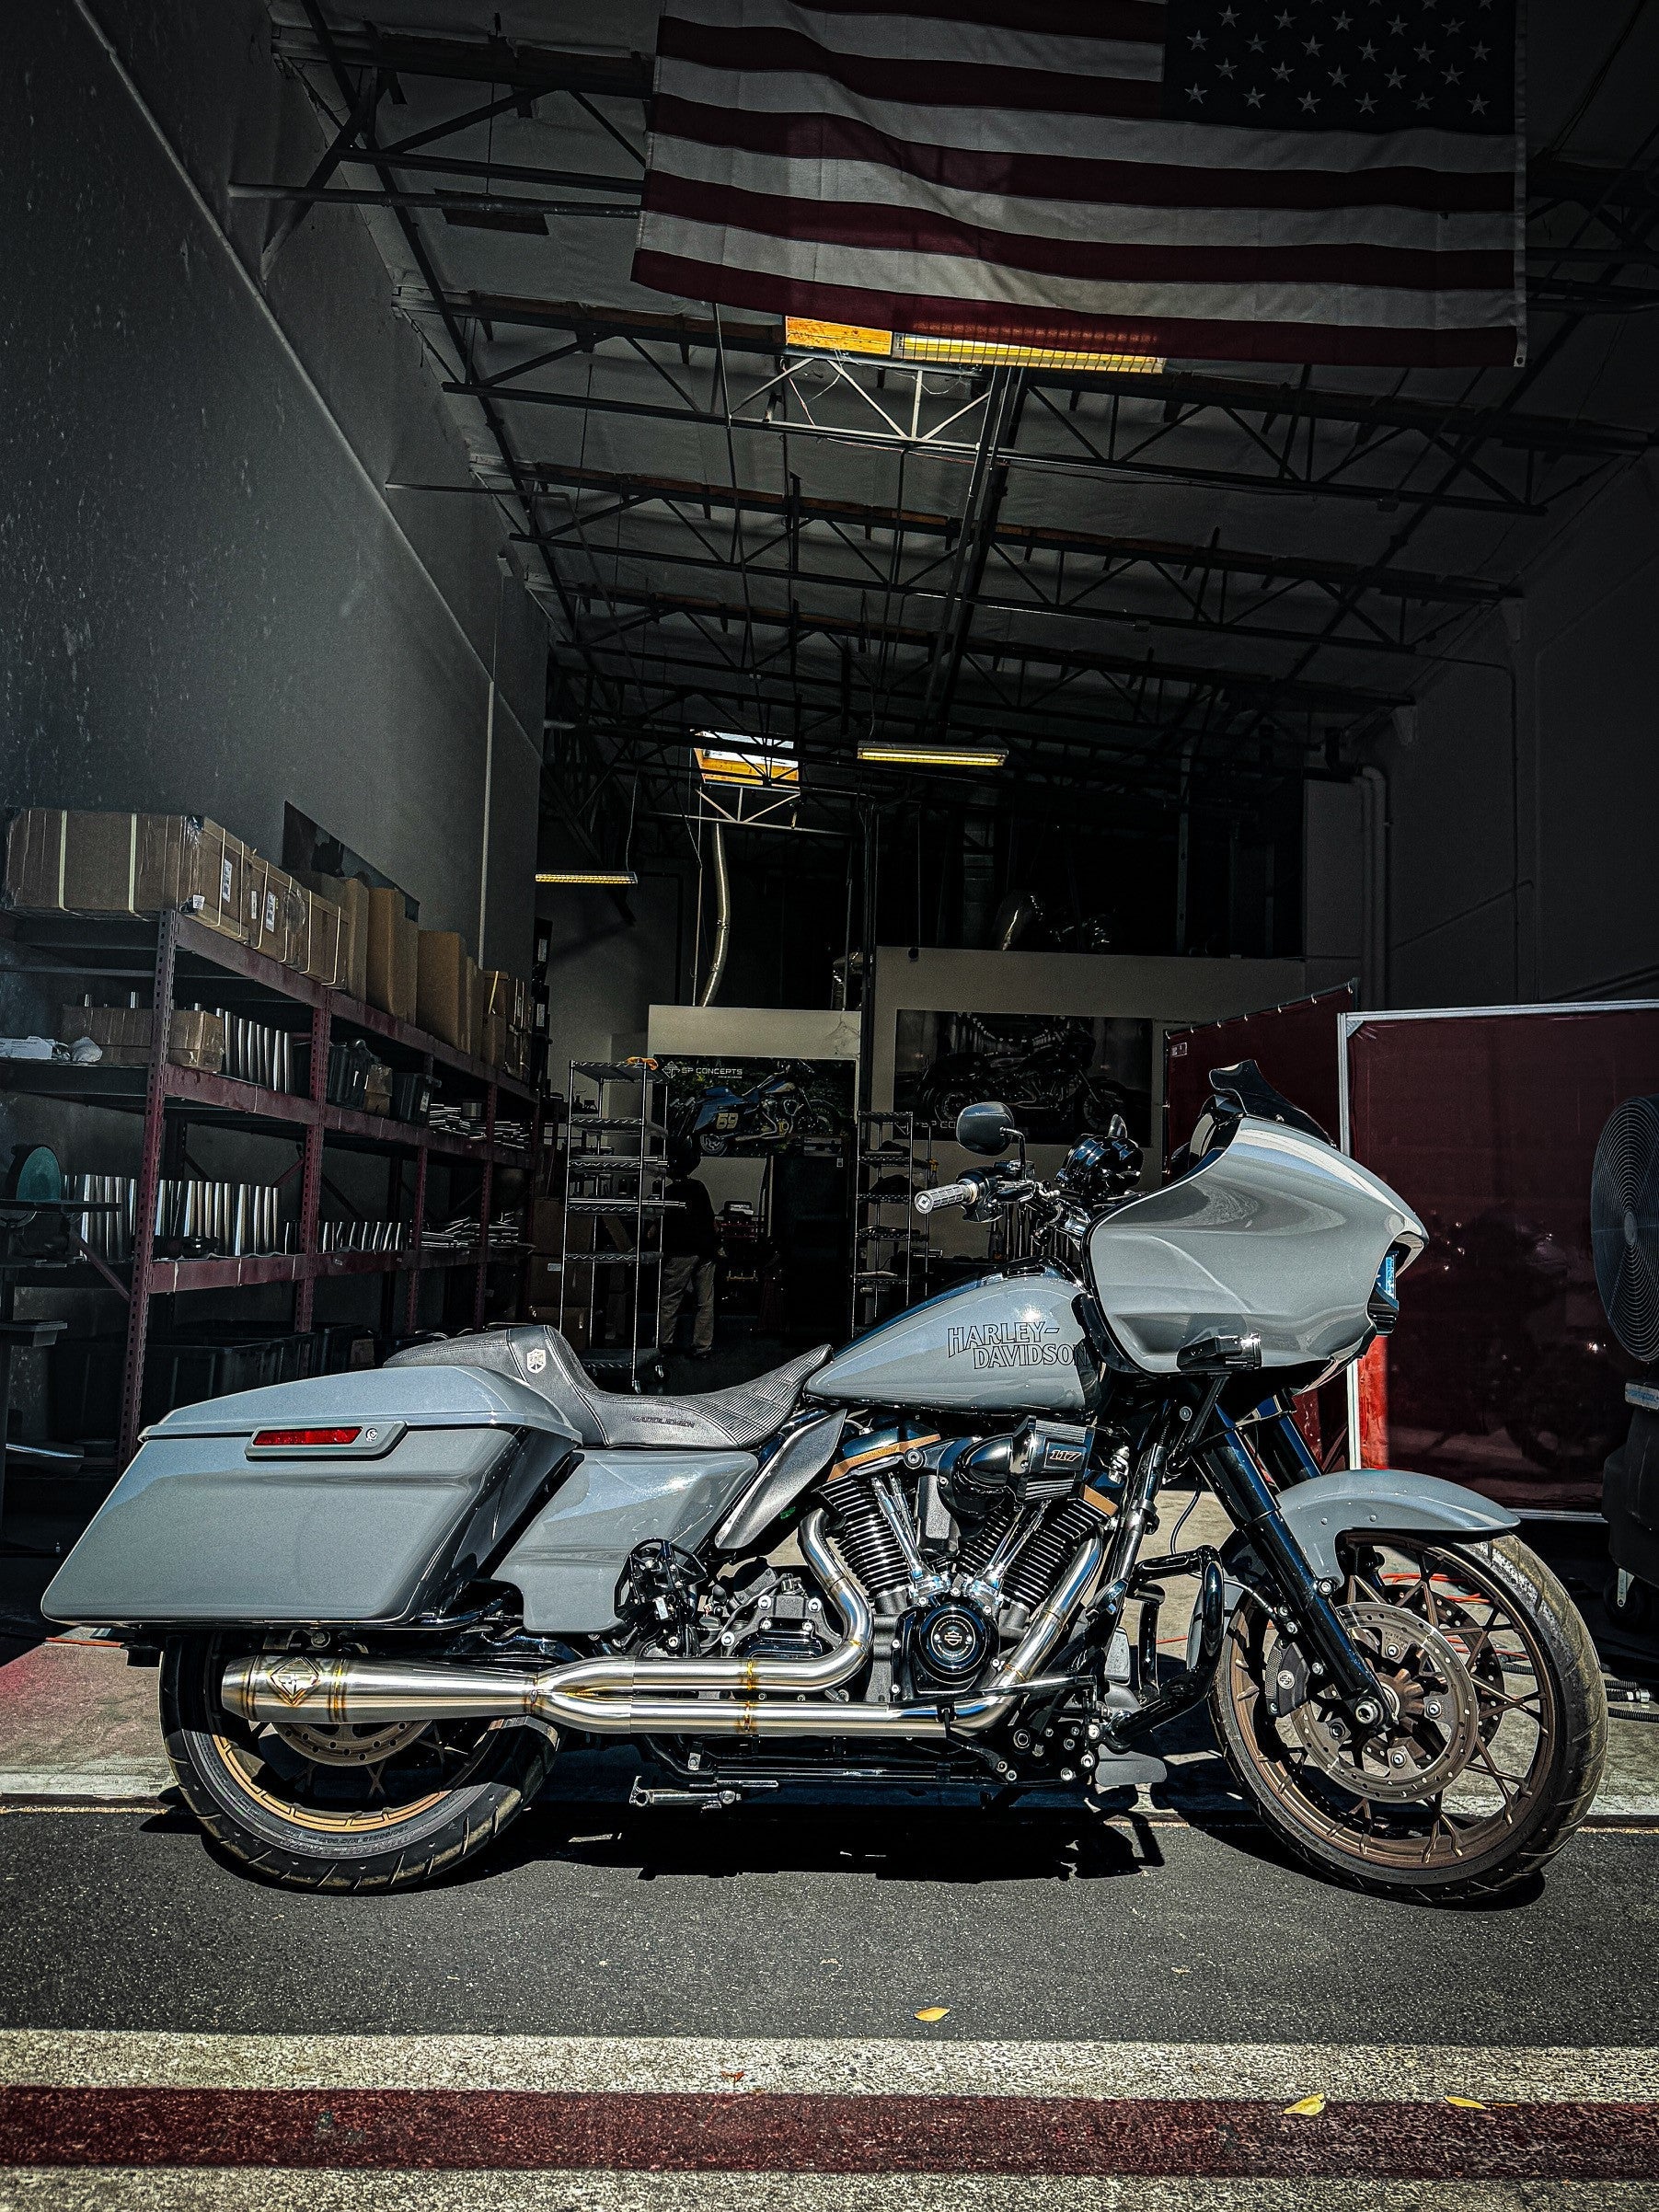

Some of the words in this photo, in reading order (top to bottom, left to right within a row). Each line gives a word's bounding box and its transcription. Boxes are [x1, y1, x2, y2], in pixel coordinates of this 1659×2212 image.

[716, 1112, 739, 1130] 69
[948, 1321, 1060, 1358] HARLEY-
[1049, 1449, 1082, 1462] 117
